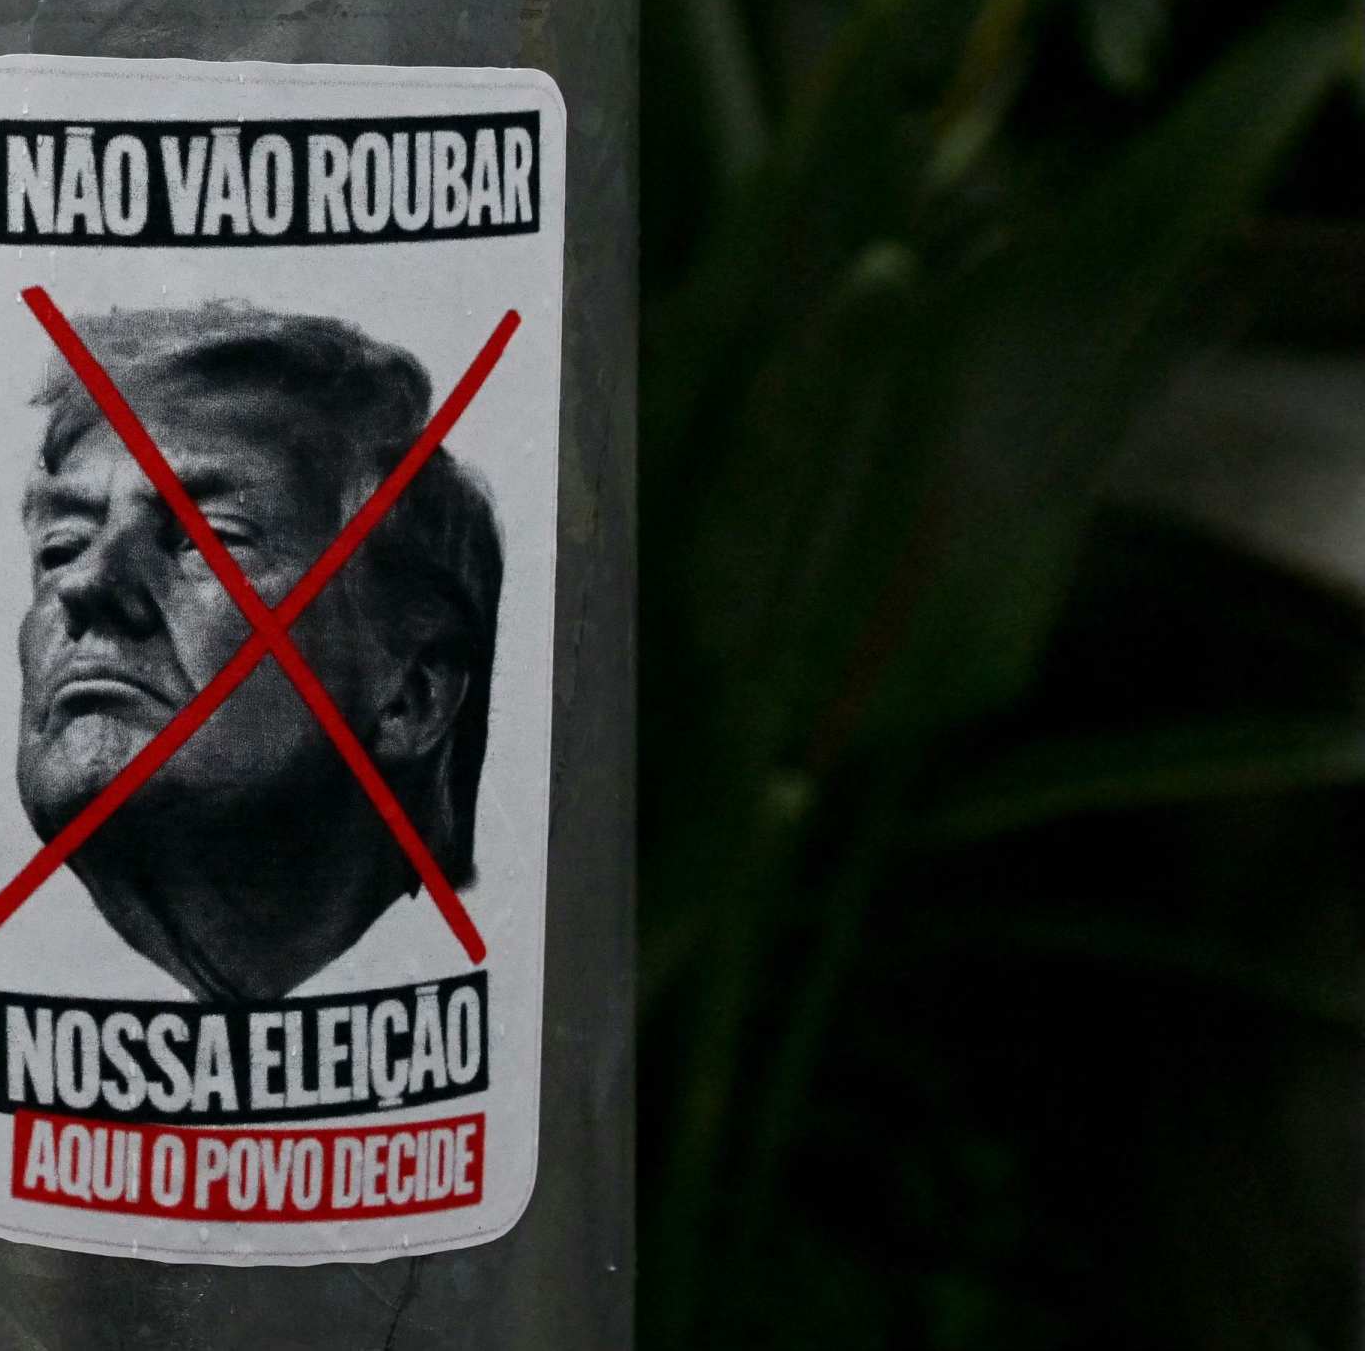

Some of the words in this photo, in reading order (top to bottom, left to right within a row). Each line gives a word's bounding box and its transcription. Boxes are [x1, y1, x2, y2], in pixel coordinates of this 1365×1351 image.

[6, 126, 149, 236] NÃO
[160, 126, 295, 236] VÃO
[307, 126, 533, 234] ROUBAR
[4, 1004, 240, 1114] NOSSA
[248, 985, 482, 1109] ELEIÇÃO
[23, 1118, 140, 1204] AQUI
[151, 1133, 187, 1208] O
[194, 1136, 325, 1212] POVO
[331, 1123, 477, 1211] DECIDE
